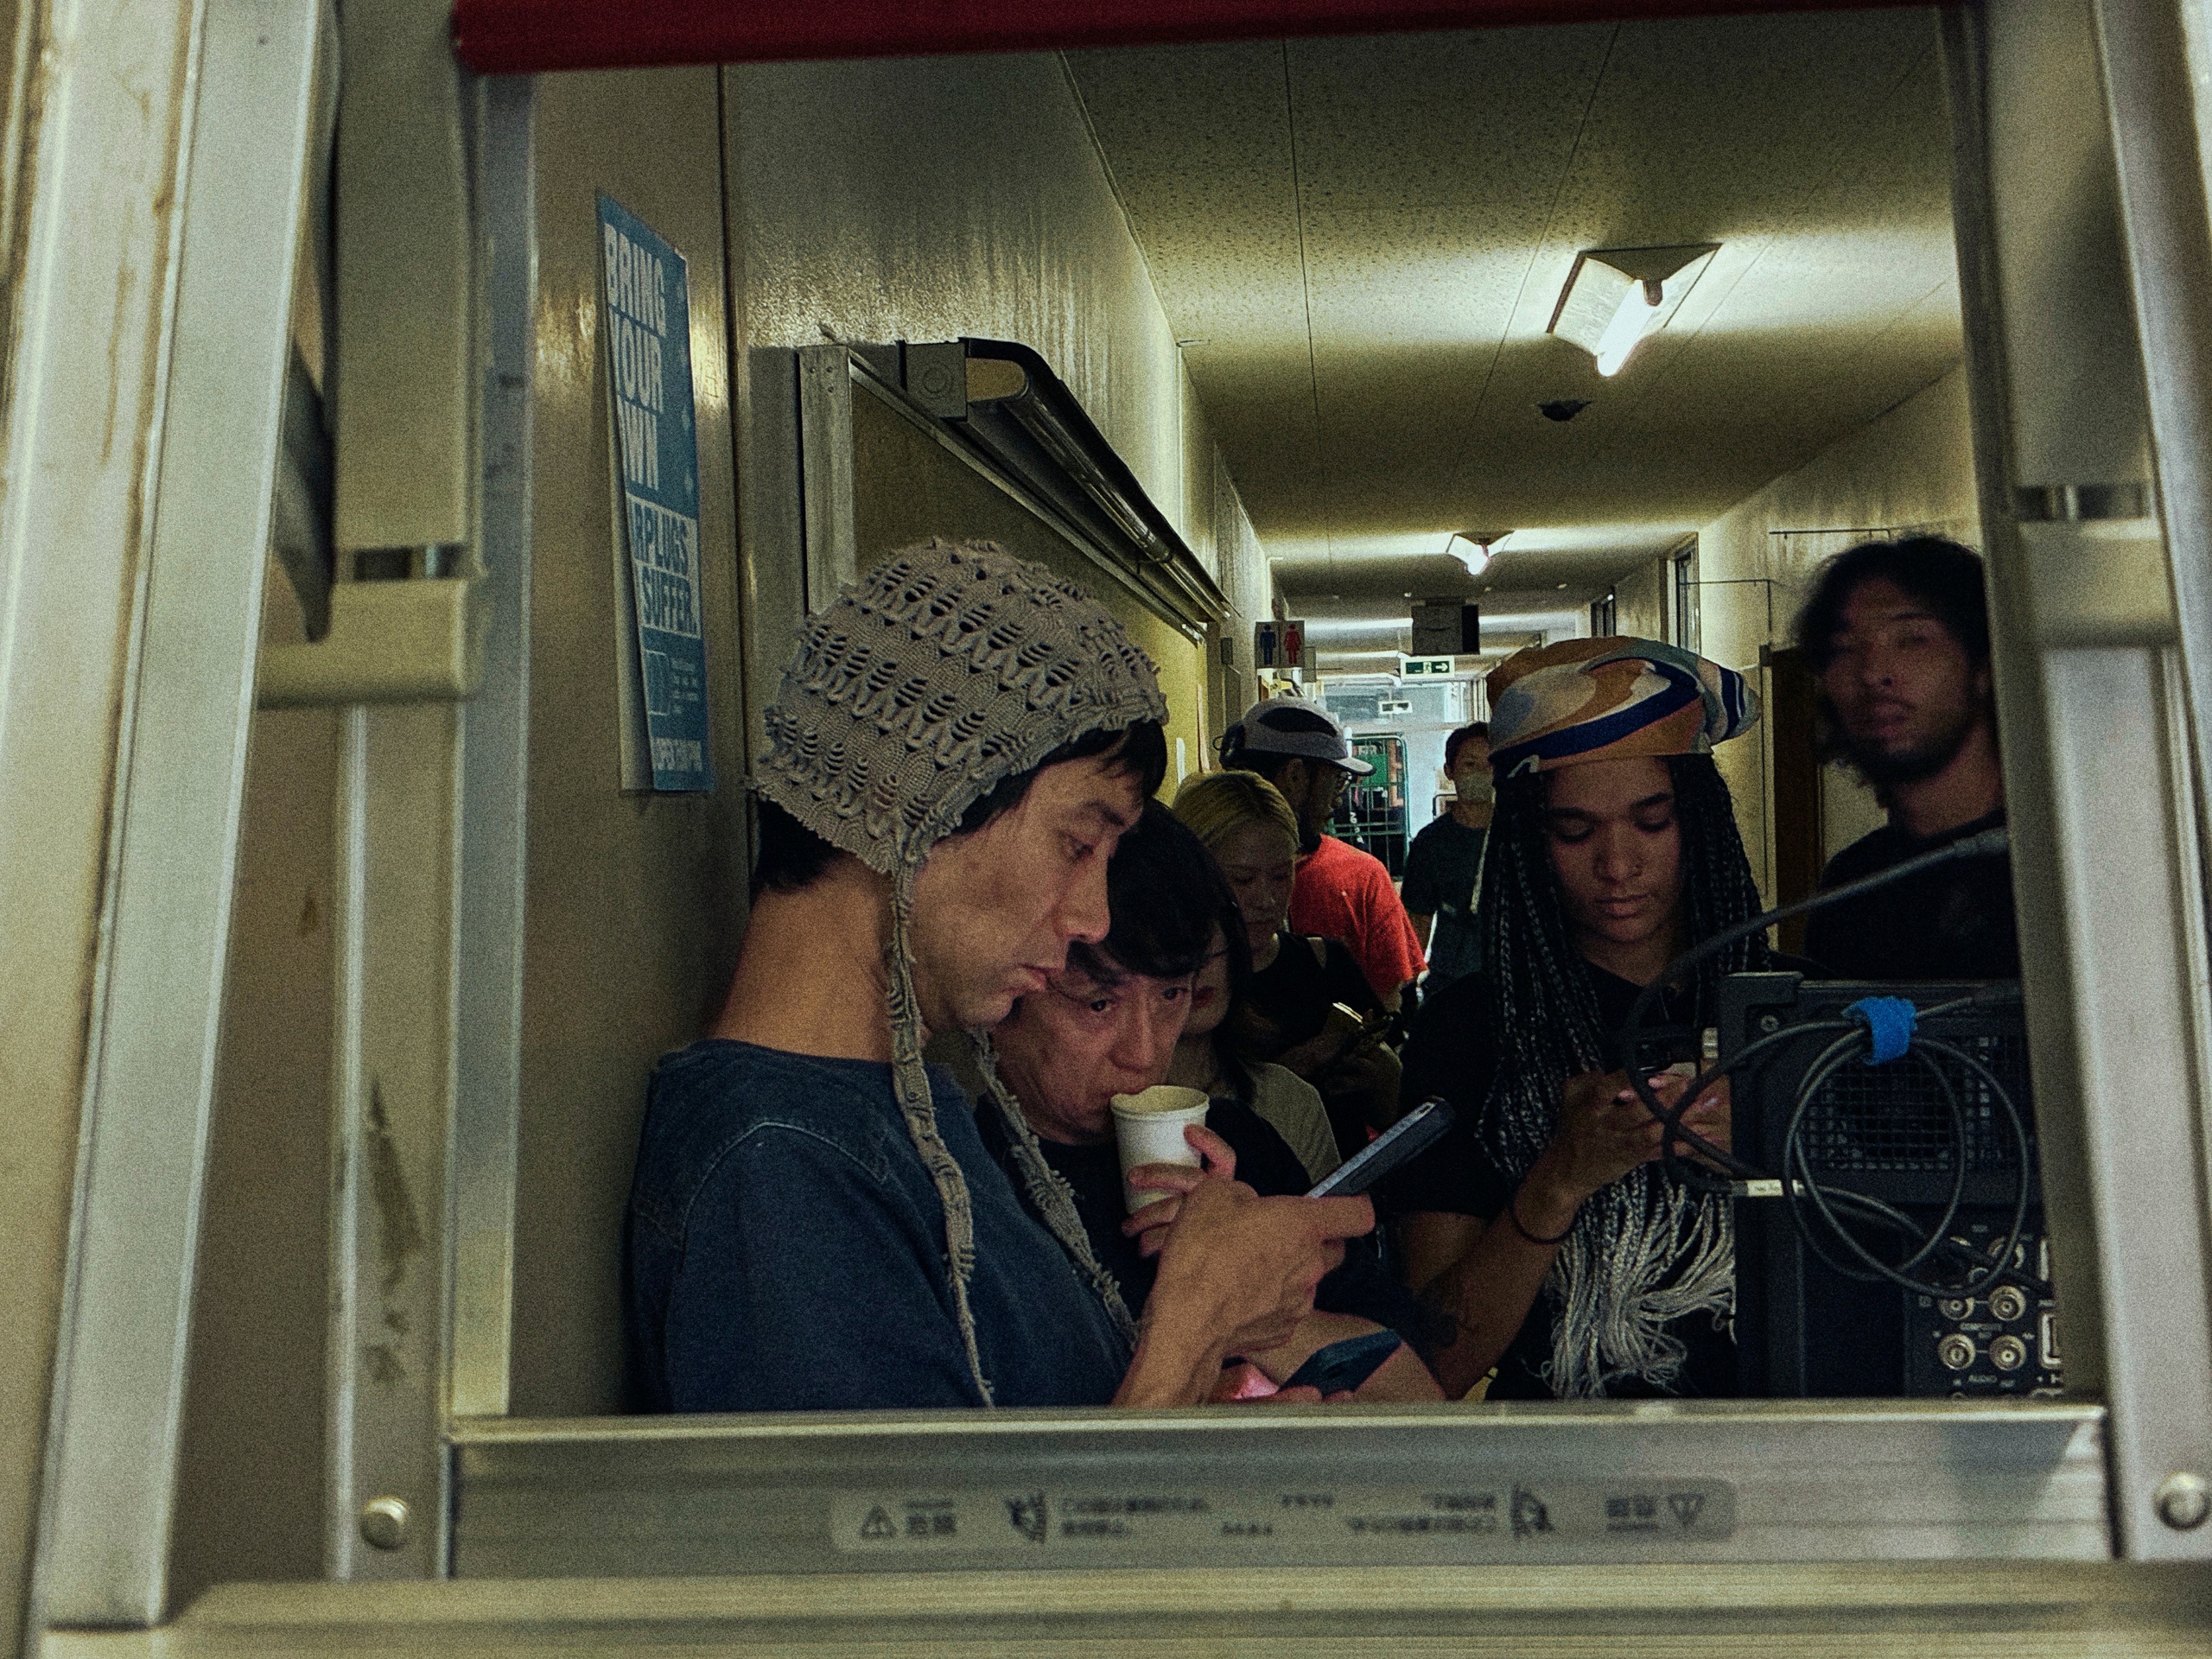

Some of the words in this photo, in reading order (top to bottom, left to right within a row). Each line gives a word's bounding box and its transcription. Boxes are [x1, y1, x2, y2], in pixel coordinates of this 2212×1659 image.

[604, 222, 667, 338] BRING
[608, 307, 664, 414] YOUR
[629, 499, 689, 575] RPLUGS
